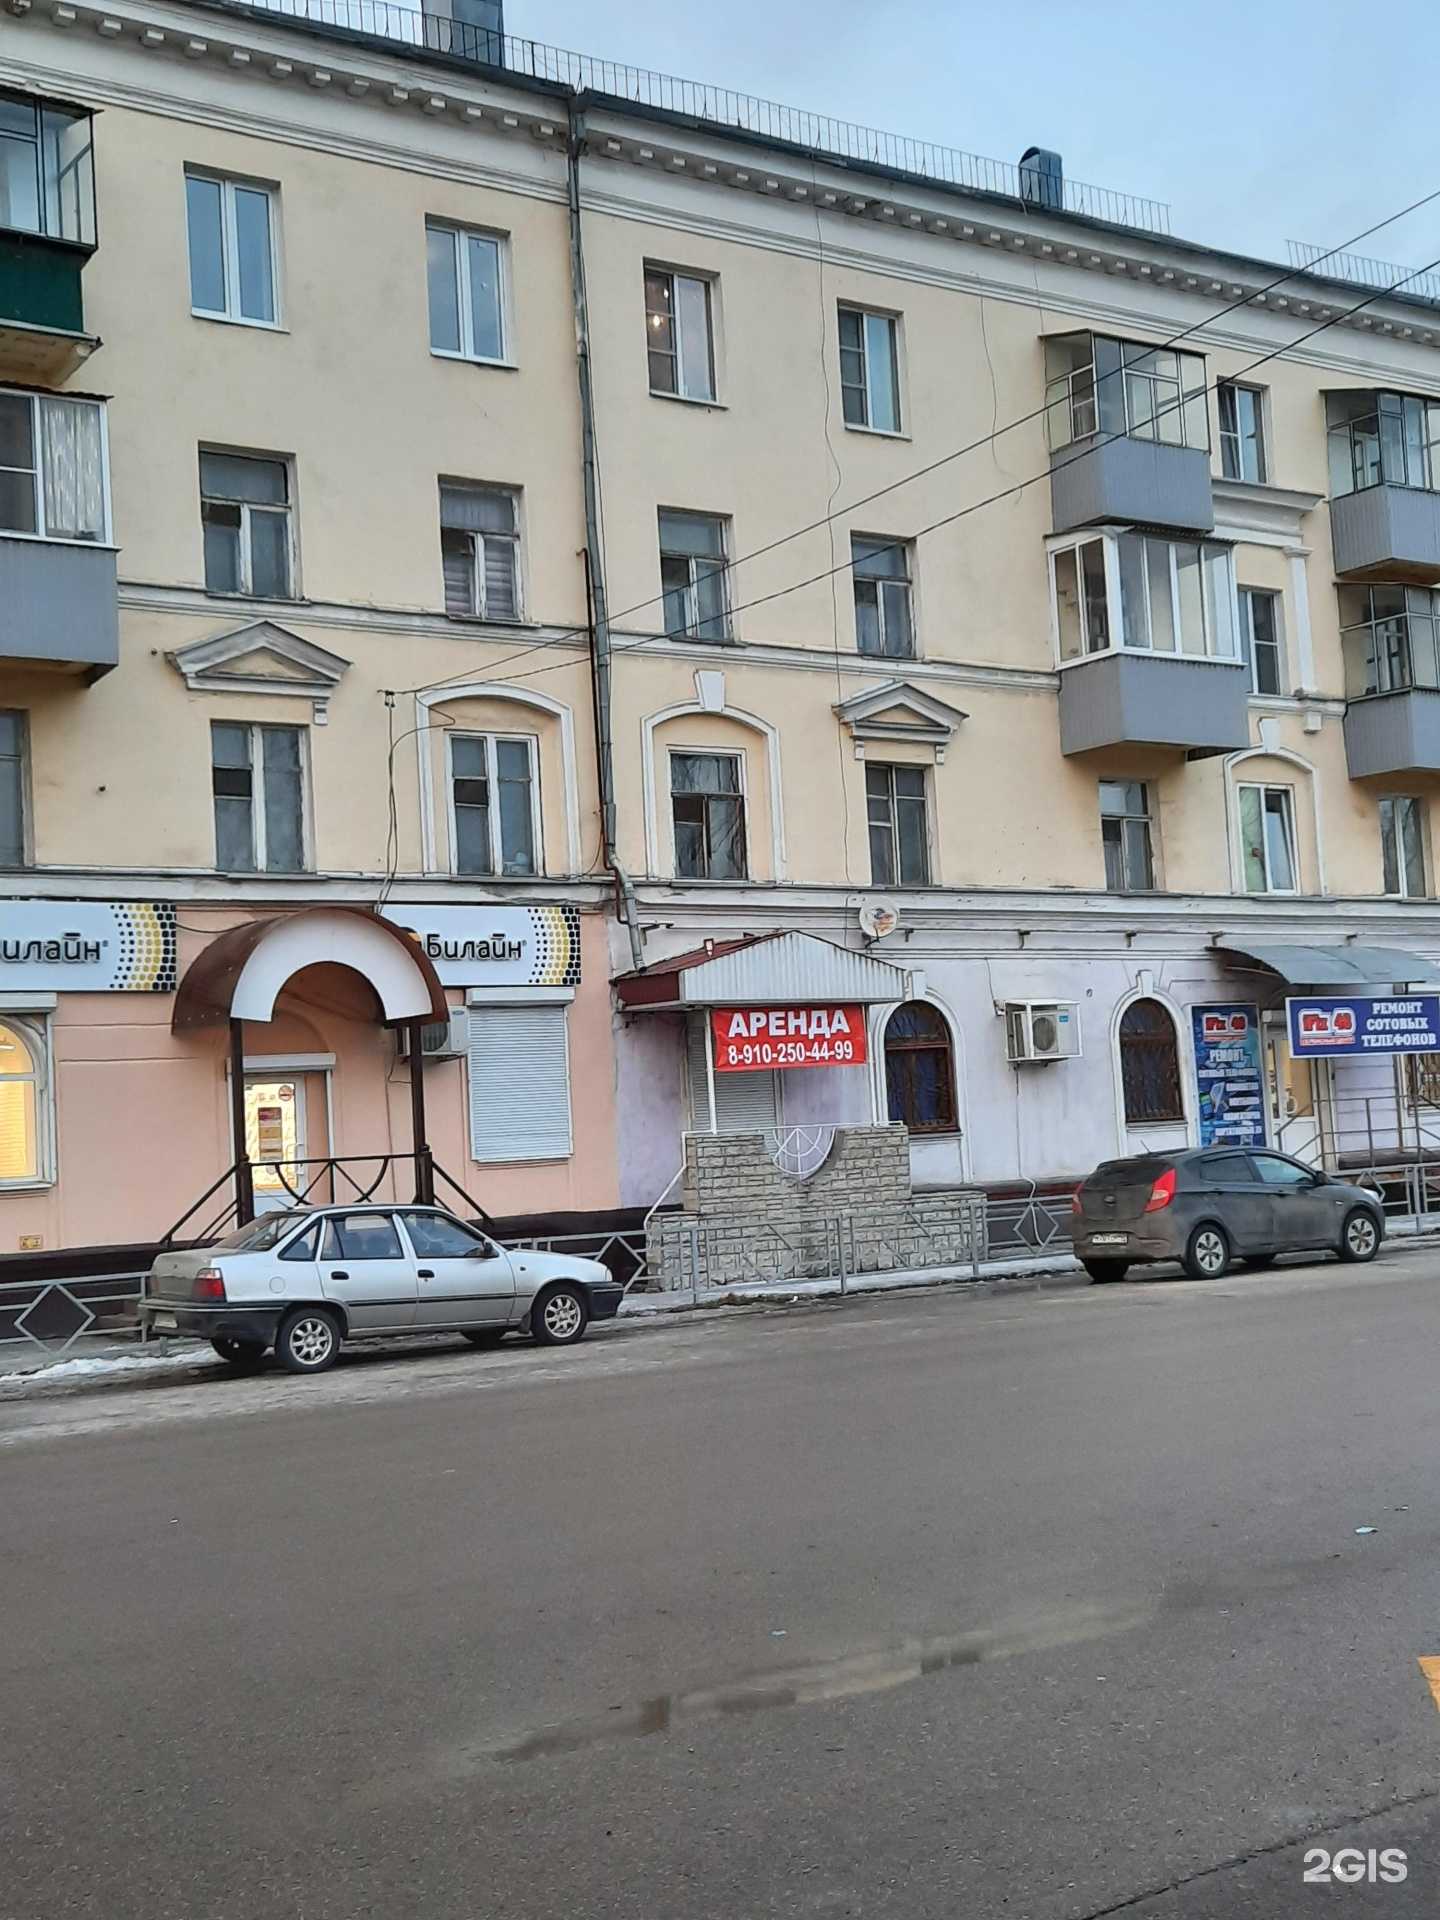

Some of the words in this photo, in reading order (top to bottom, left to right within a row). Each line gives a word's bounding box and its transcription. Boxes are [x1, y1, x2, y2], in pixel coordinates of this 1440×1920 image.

[0, 932, 101, 961] илайн
[426, 933, 522, 959] Билайн
[1372, 1002, 1423, 1015] РЕМОНТ
[728, 1009, 850, 1039] АРЕНДА
[1366, 1018, 1429, 1031] СОТОВЫХ
[728, 1040, 853, 1065] 8-910-250-44-99
[1361, 1033, 1437, 1047] ТЕЛЕФОНОВ
